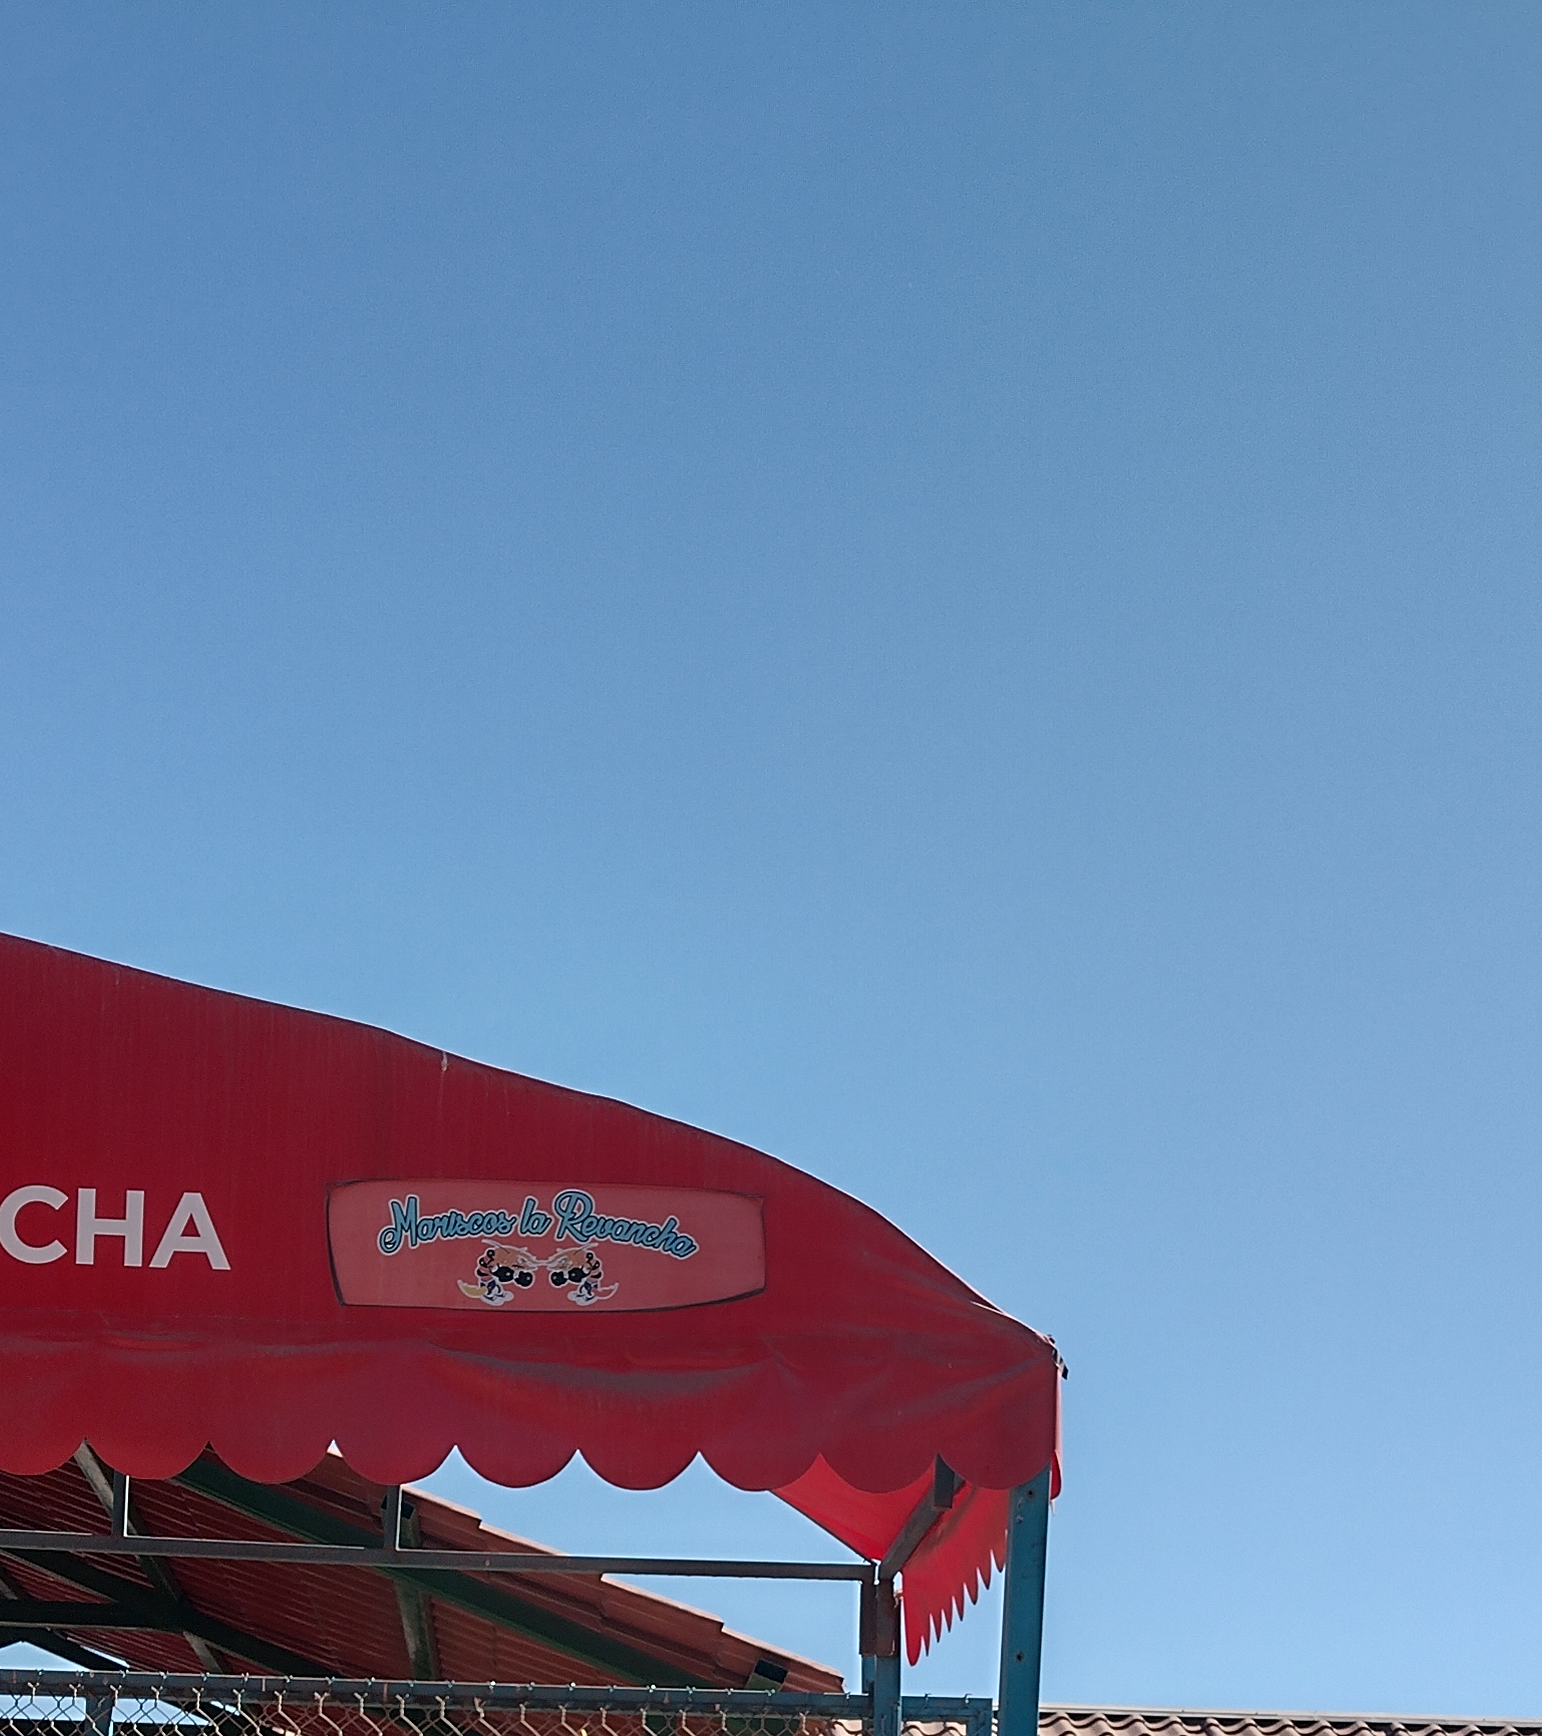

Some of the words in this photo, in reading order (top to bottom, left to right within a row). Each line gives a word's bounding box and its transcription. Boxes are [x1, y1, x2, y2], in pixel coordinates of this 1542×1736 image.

[378, 1195, 517, 1255] Mariscos
[519, 1197, 553, 1236] la
[554, 1189, 699, 1257] Revancha
